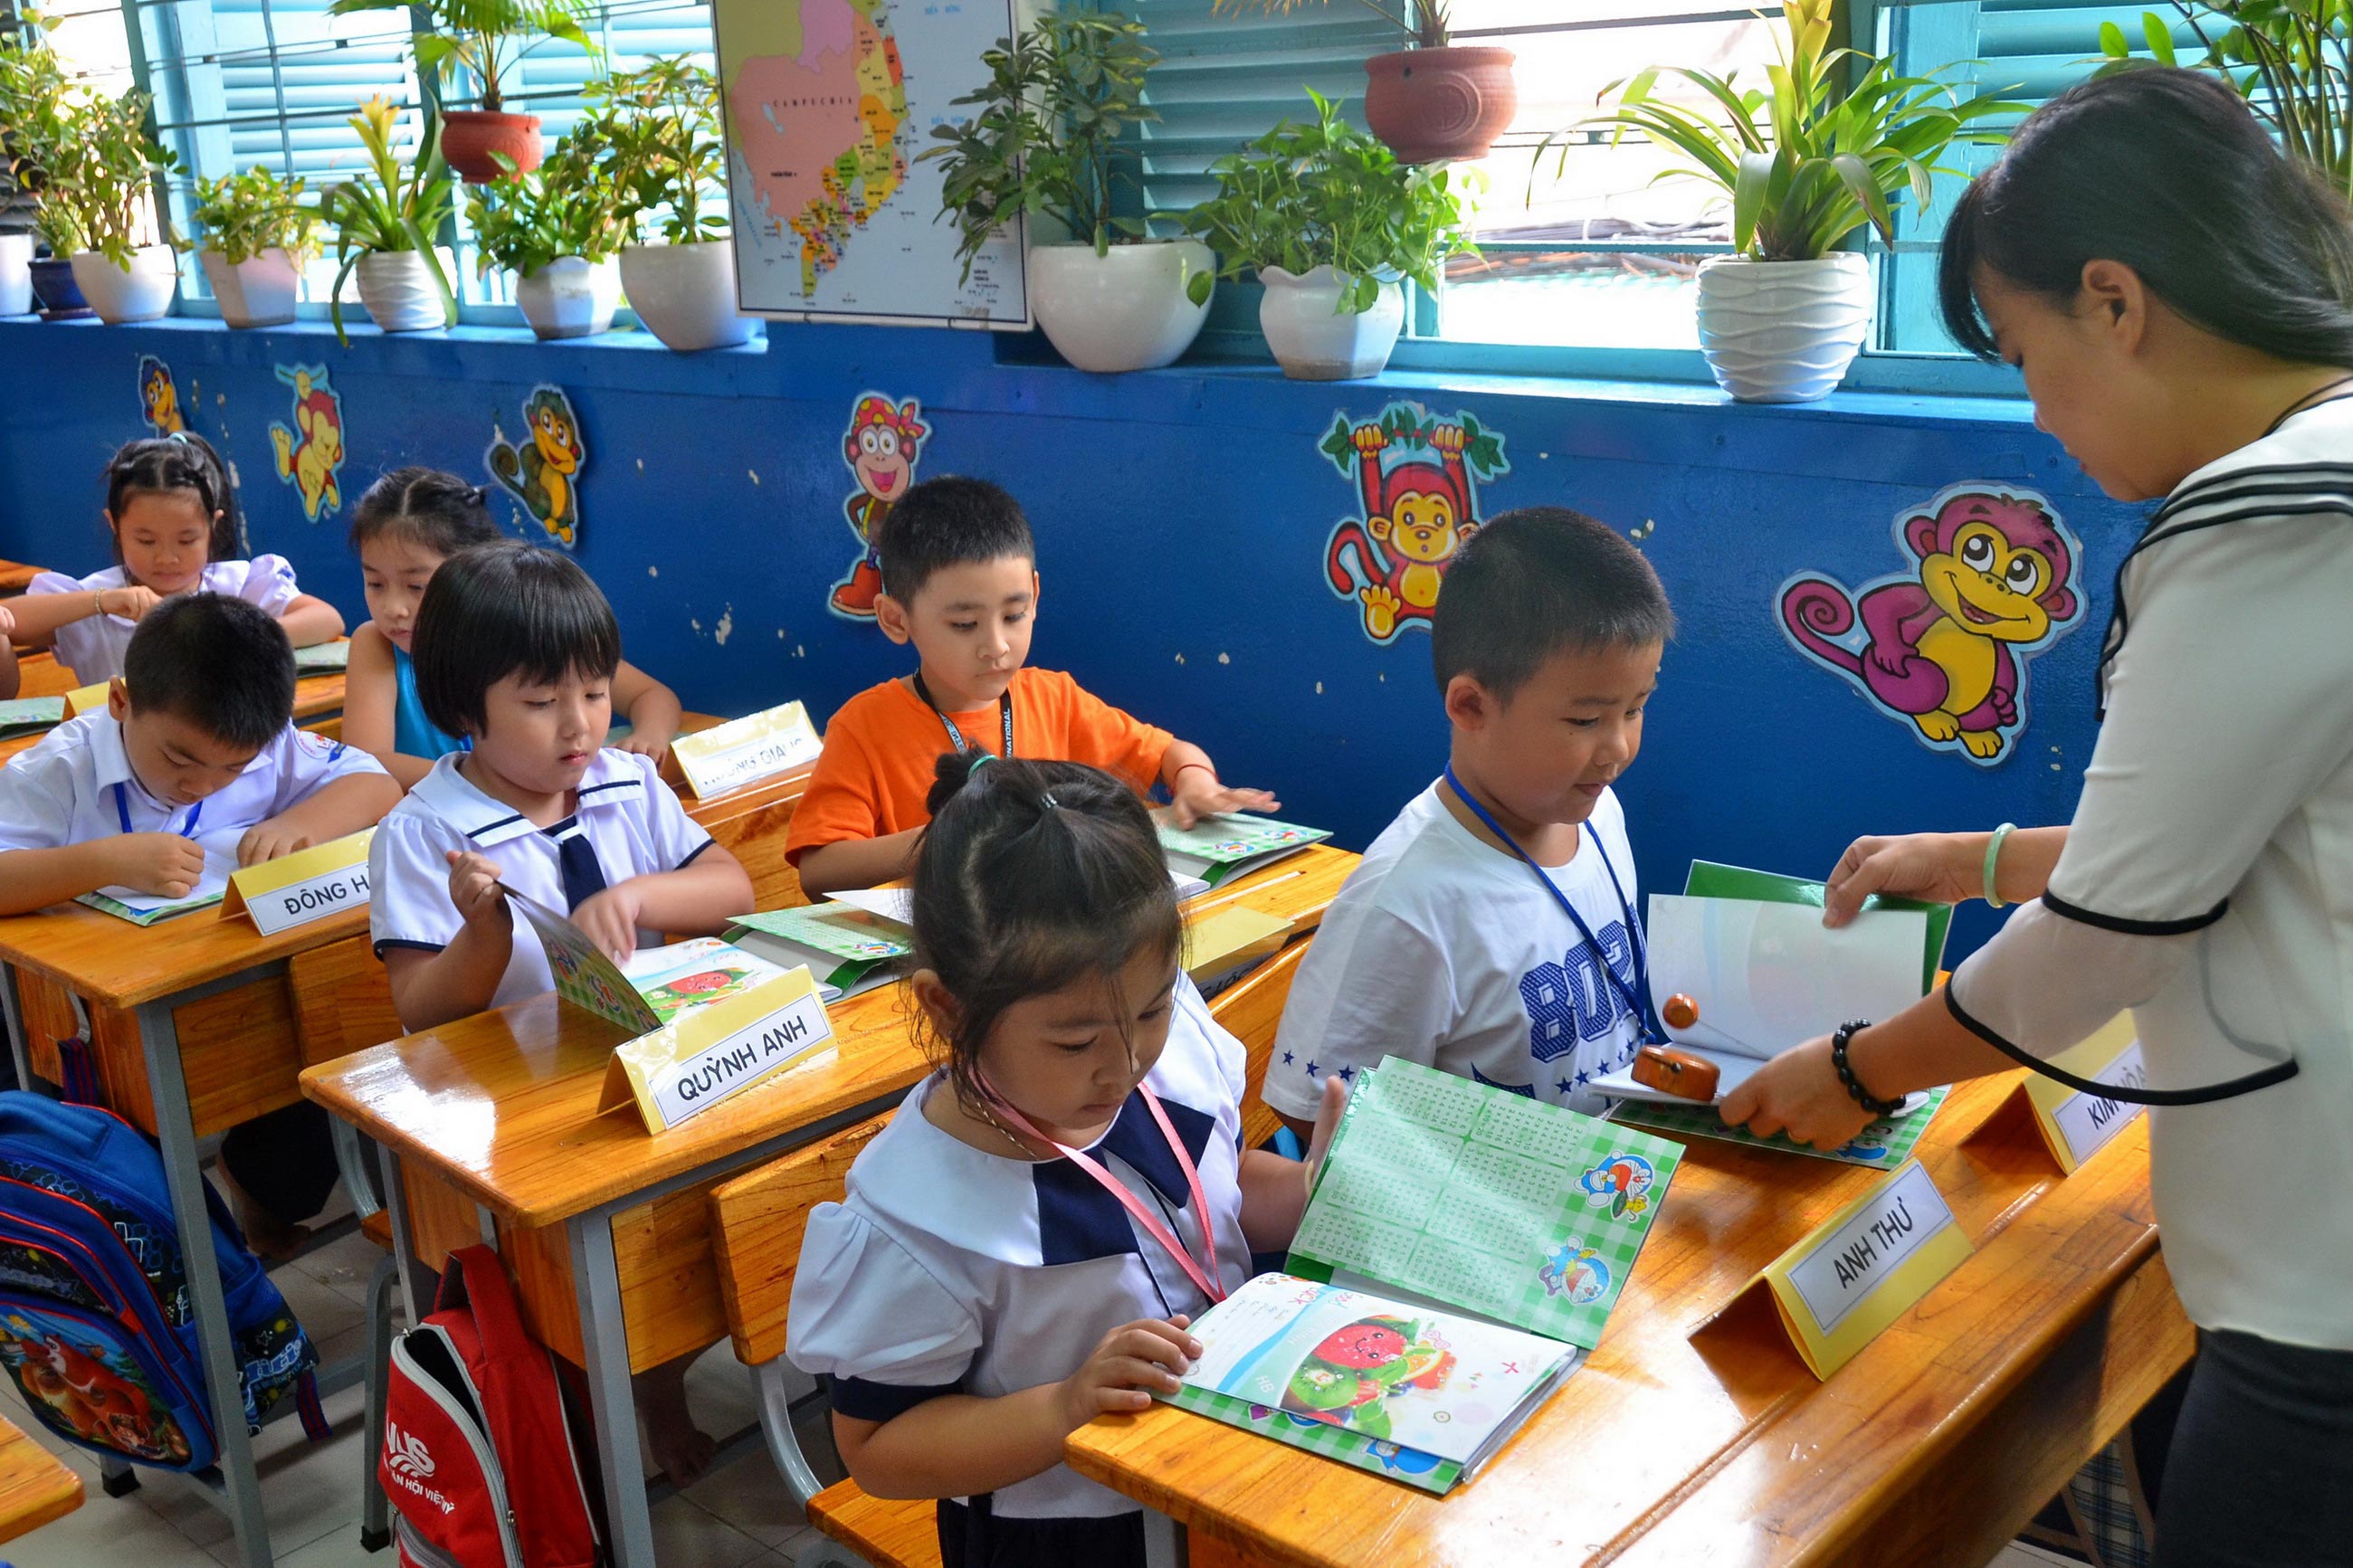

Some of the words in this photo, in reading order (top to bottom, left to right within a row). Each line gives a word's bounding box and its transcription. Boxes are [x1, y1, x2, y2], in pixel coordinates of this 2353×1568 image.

[283, 882, 348, 916] ĐÔNG
[350, 873, 369, 893] H
[678, 1043, 757, 1101] QUỲNH
[762, 1015, 808, 1058] ANH
[1834, 1236, 1878, 1288] ANH
